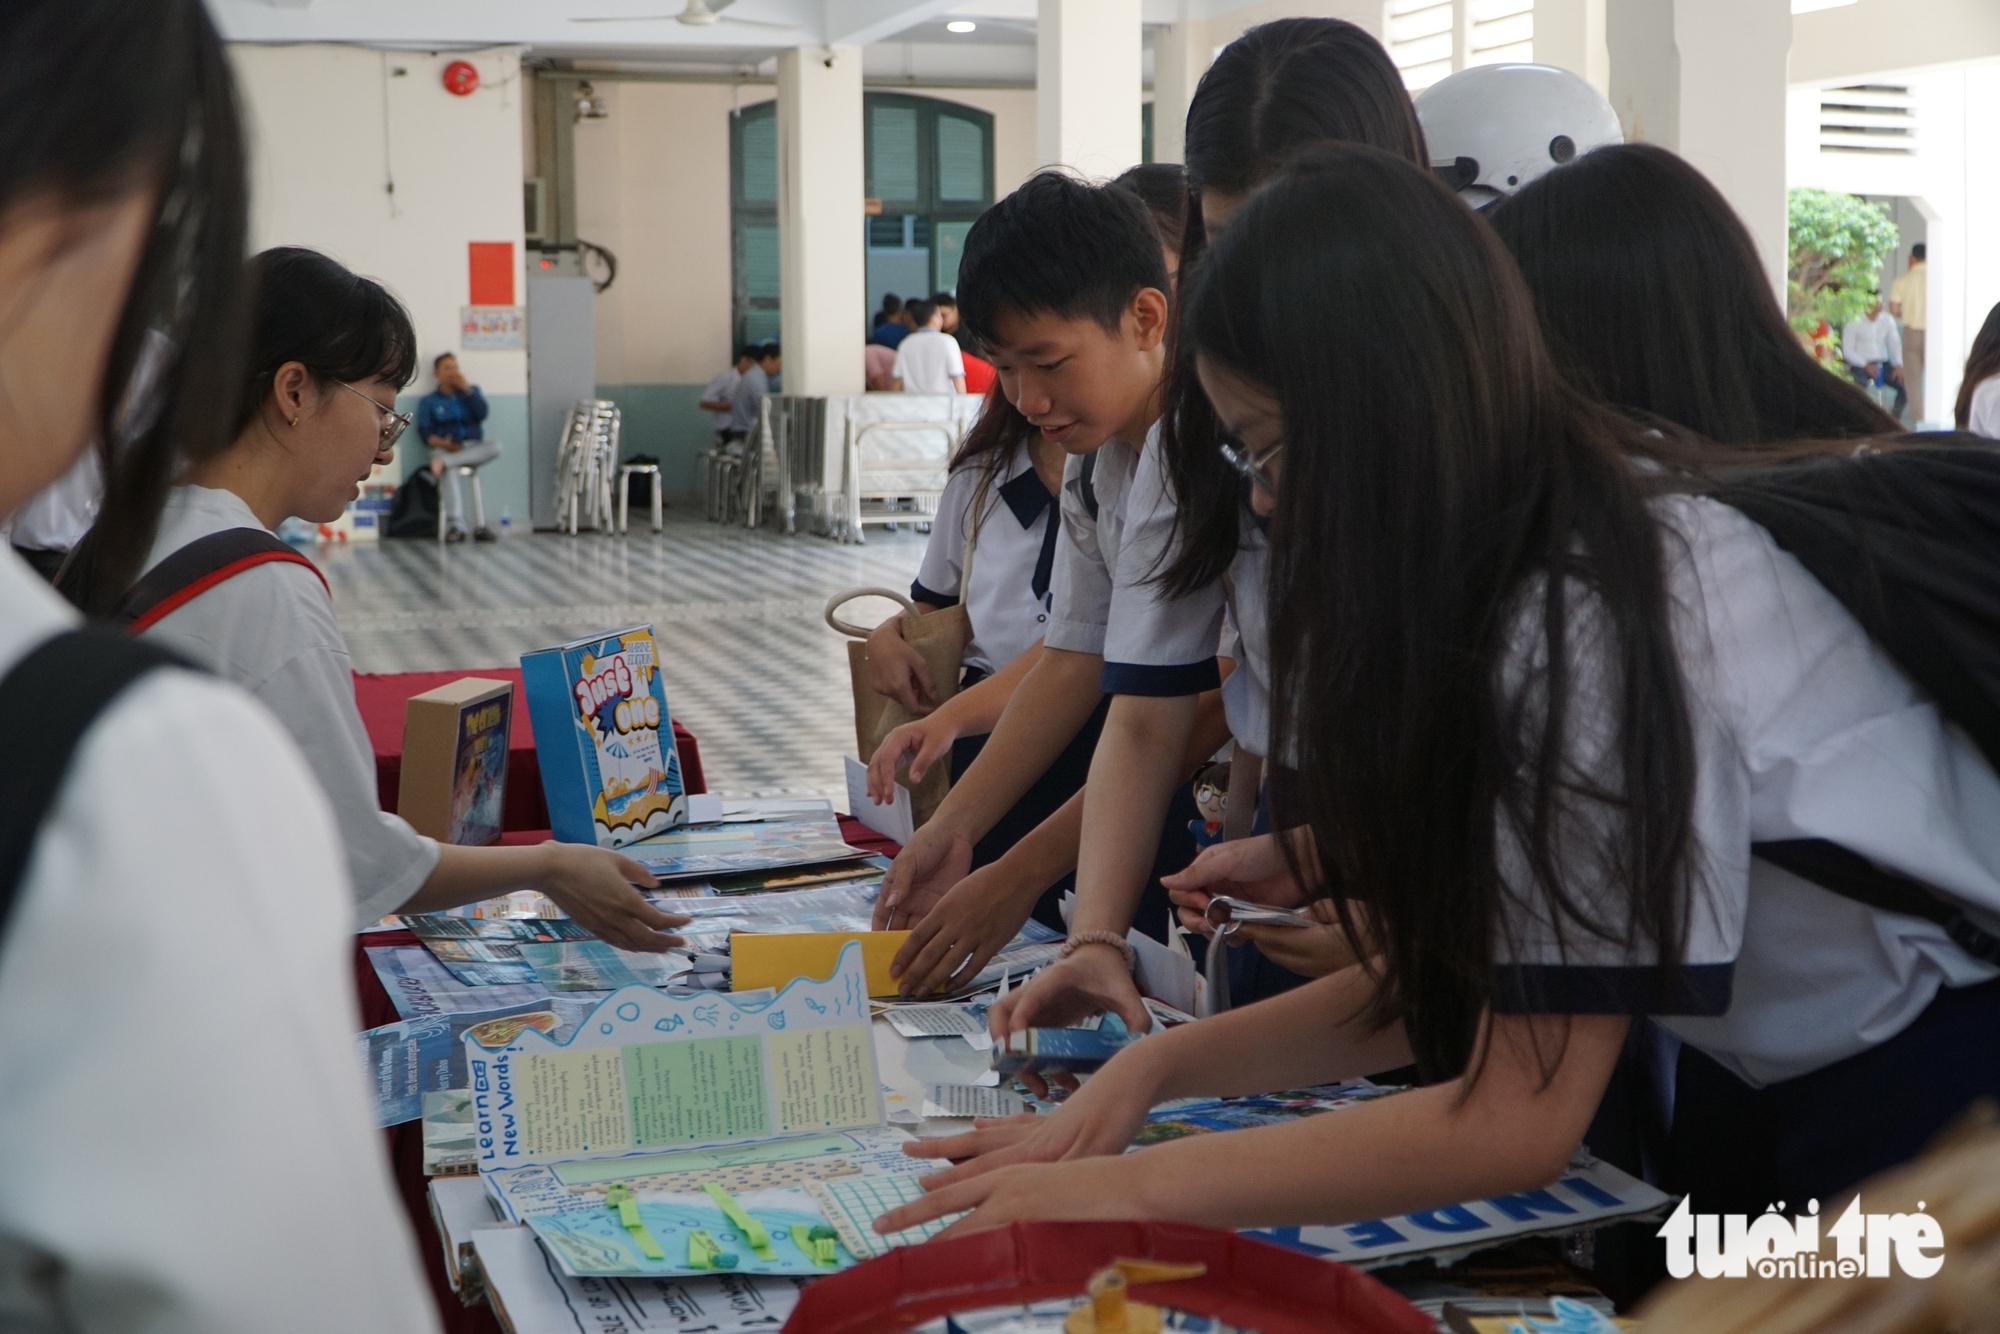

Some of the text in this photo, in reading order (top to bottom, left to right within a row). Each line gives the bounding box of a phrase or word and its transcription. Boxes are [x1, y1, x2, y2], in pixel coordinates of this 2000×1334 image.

[626, 641, 651, 654] MARINE
[627, 653, 653, 666] EDITION
[396, 975, 441, 1016] OCABULARY
[475, 1094, 495, 1160] Learn
[501, 1113, 520, 1156] New
[595, 1315, 629, 1334] BLE
